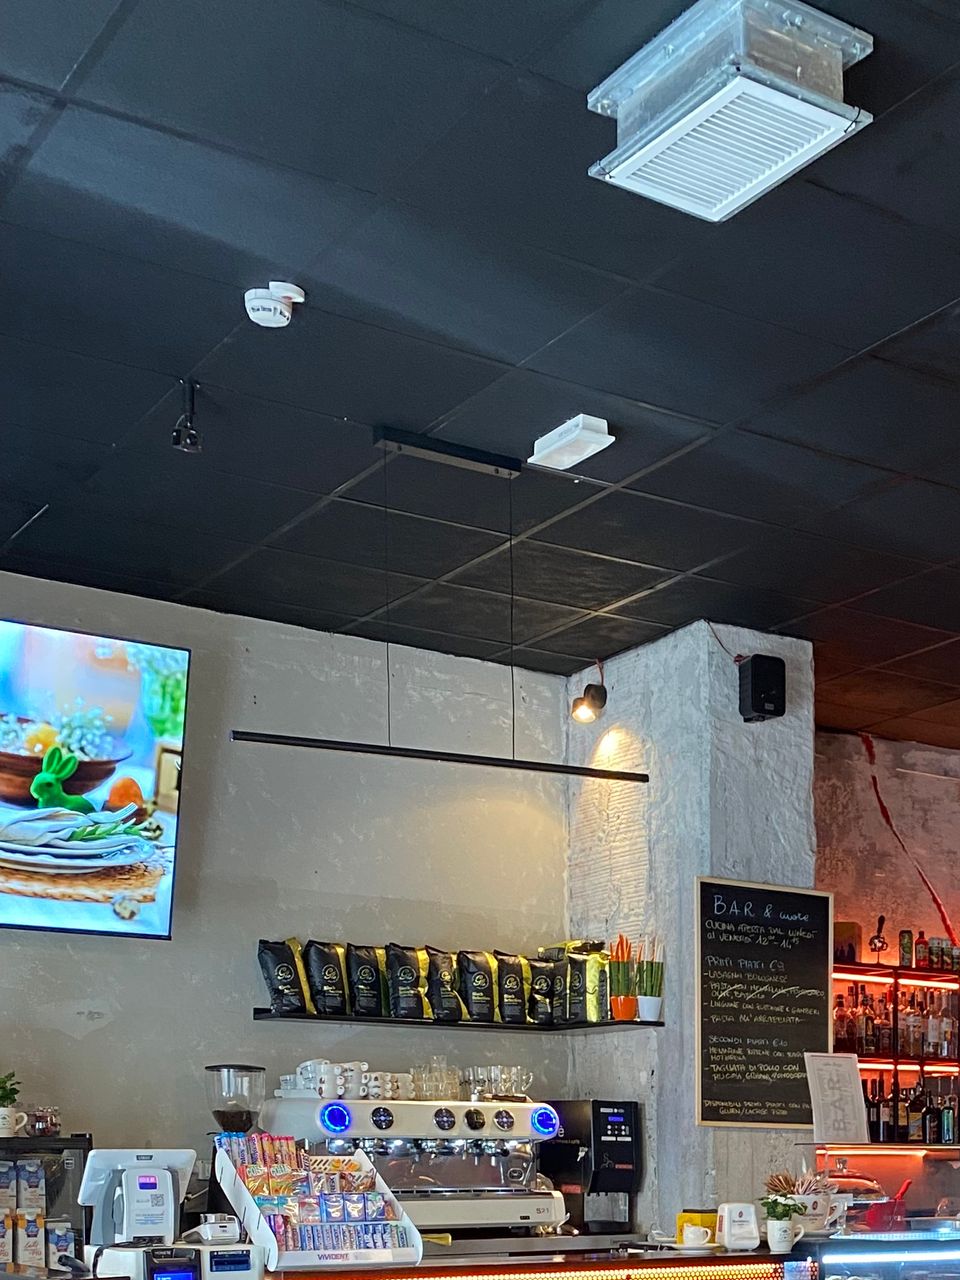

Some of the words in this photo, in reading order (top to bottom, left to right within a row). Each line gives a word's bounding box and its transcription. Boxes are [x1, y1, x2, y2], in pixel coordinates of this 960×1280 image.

[714, 895, 754, 918] BAR
[764, 904, 773, 918] &
[318, 1254, 350, 1262] VIVIDENT
